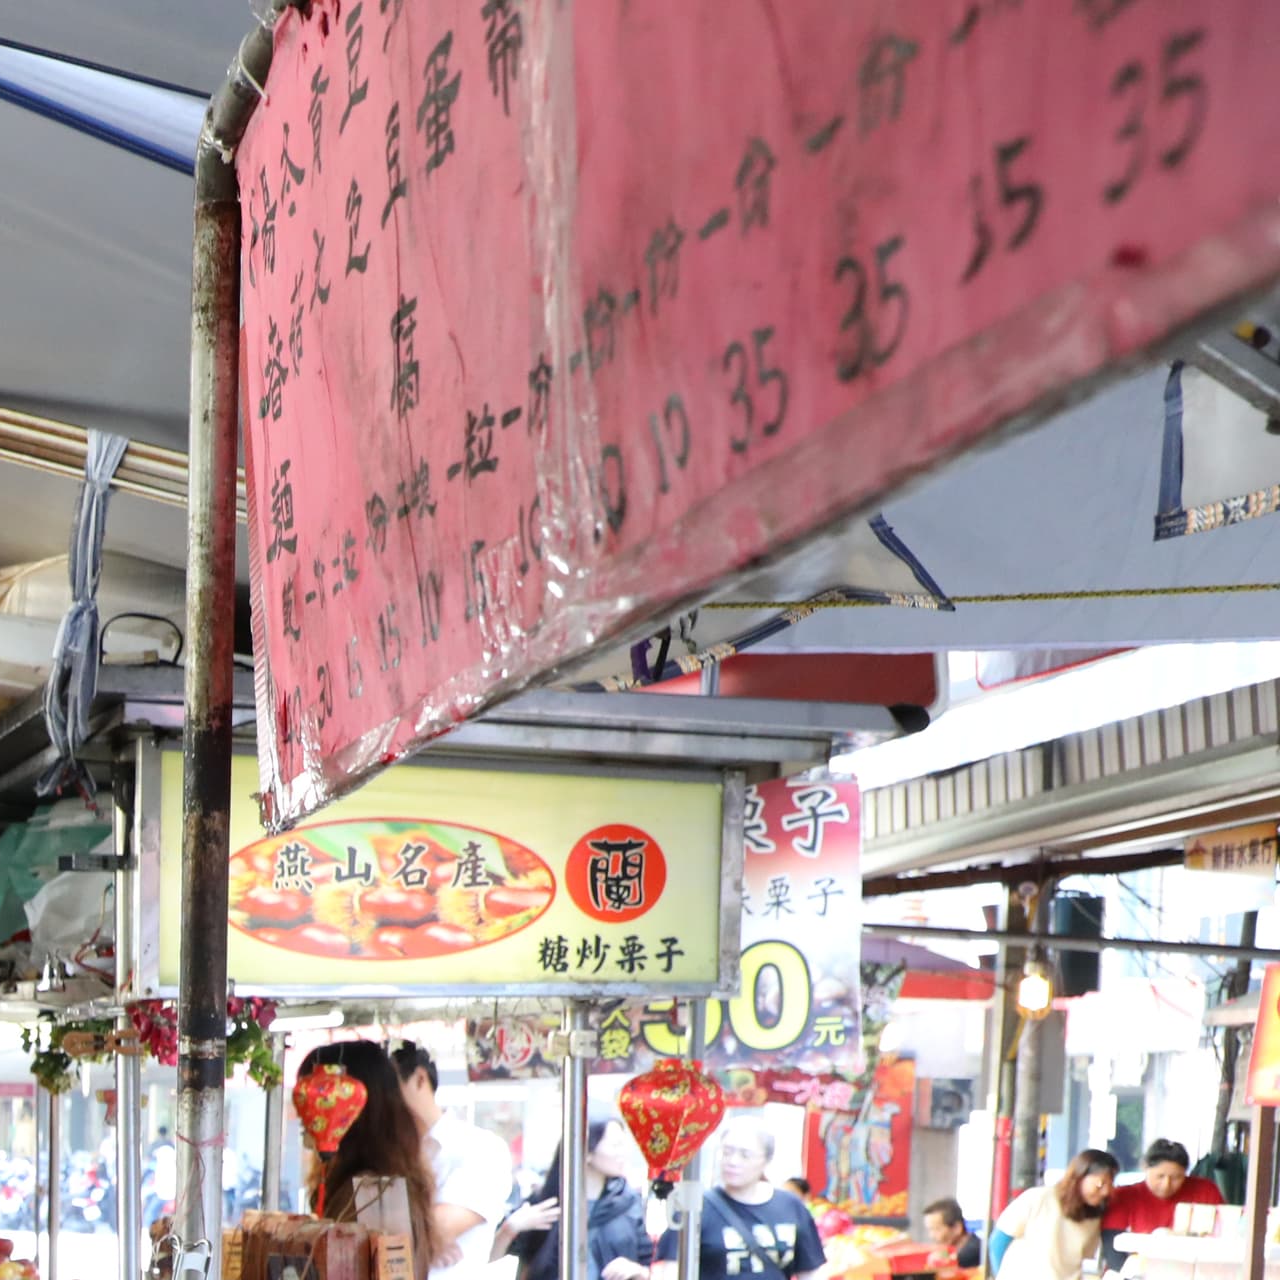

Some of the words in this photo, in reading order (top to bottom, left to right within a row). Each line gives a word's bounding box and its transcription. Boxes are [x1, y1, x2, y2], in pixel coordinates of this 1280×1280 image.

[1102, 27, 1209, 208] 35
[417, 29, 462, 179] 蛋
[447, 403, 498, 488] 一粒
[834, 232, 911, 385] 35
[380, 0, 419, 423] 豆腐
[421, 570, 441, 648] 10
[722, 325, 790, 454] 35
[378, 602, 401, 672] 15
[274, 840, 493, 892] 燕山名產
[588, 839, 646, 911] 蘭
[539, 934, 685, 975] 糖炒栗子
